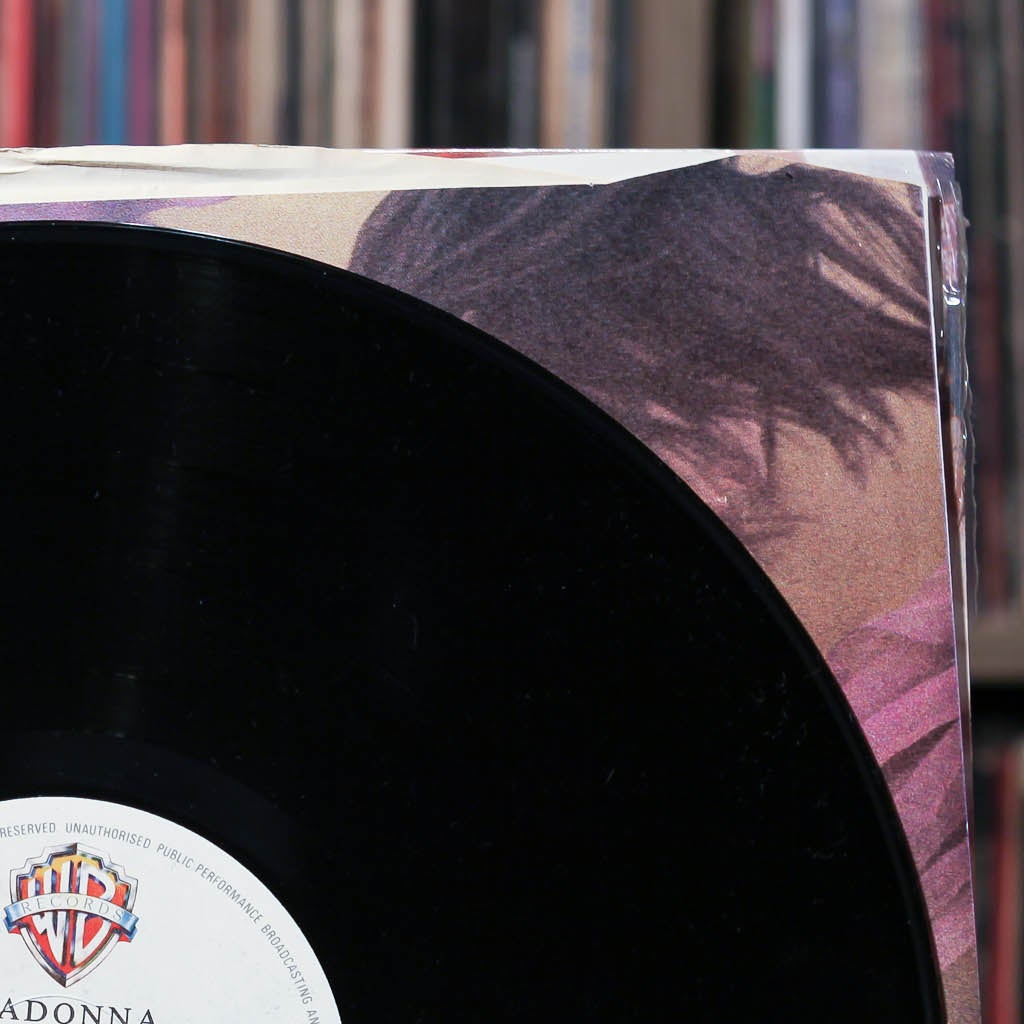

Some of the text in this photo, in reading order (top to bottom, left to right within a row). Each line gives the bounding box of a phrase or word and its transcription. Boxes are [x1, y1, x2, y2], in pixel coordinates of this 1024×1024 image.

[0, 822, 56, 838] RESERVED
[20, 896, 124, 920] RECORDS
[65, 822, 152, 849] UNAUTHORISED
[156, 843, 197, 869] PUBLIC
[194, 864, 264, 924] PERFORMANCE
[261, 924, 313, 1005] BROADCASTING
